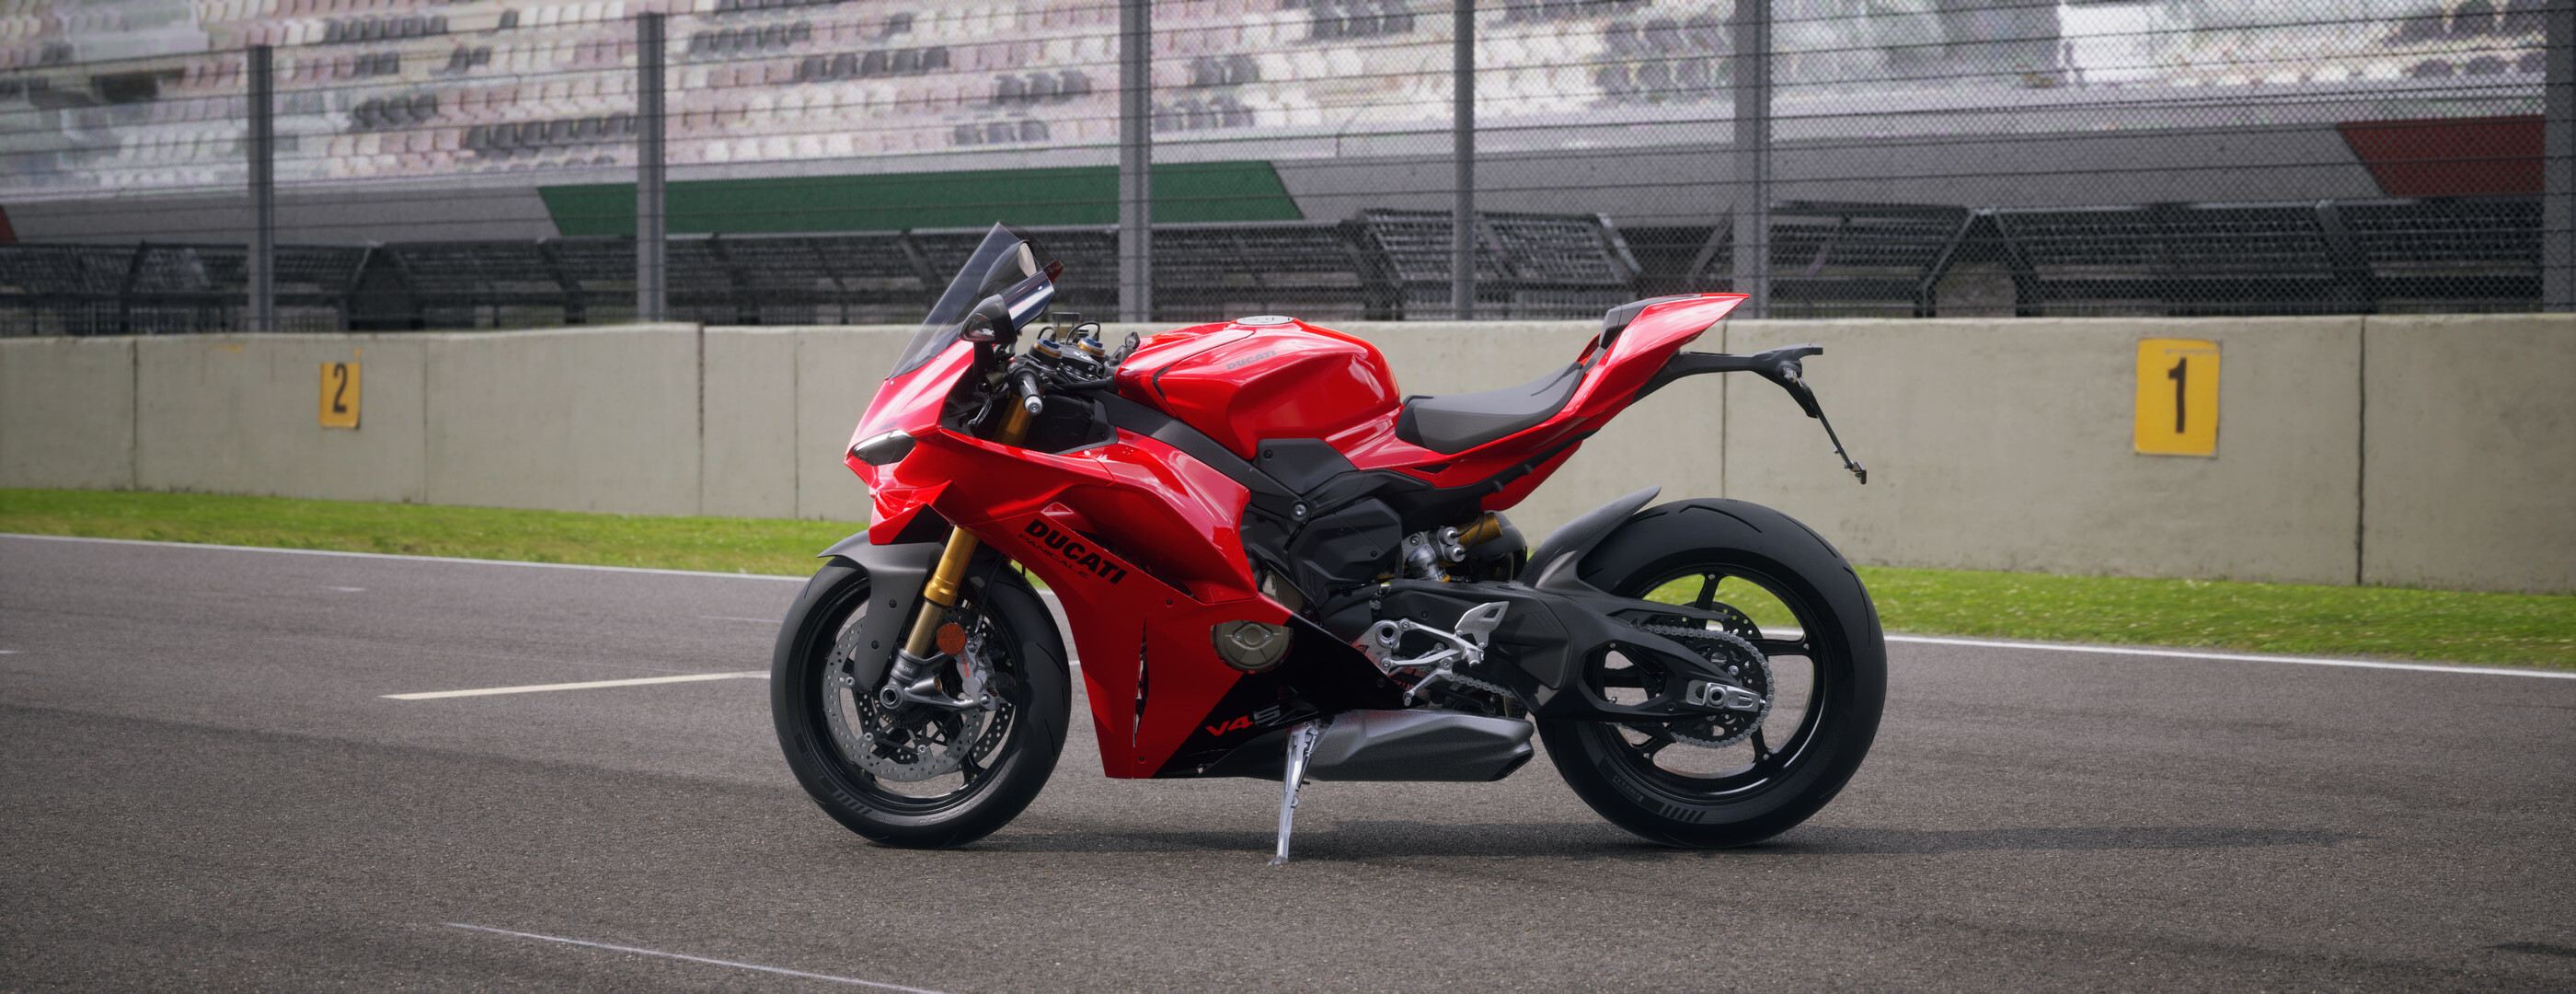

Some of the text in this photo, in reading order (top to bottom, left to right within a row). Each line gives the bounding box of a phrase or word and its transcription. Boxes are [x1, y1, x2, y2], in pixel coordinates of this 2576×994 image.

[332, 362, 348, 414] 2
[1226, 350, 1277, 370] DUCATI
[2168, 355, 2187, 434] 1
[1024, 518, 1128, 584] DUCATI
